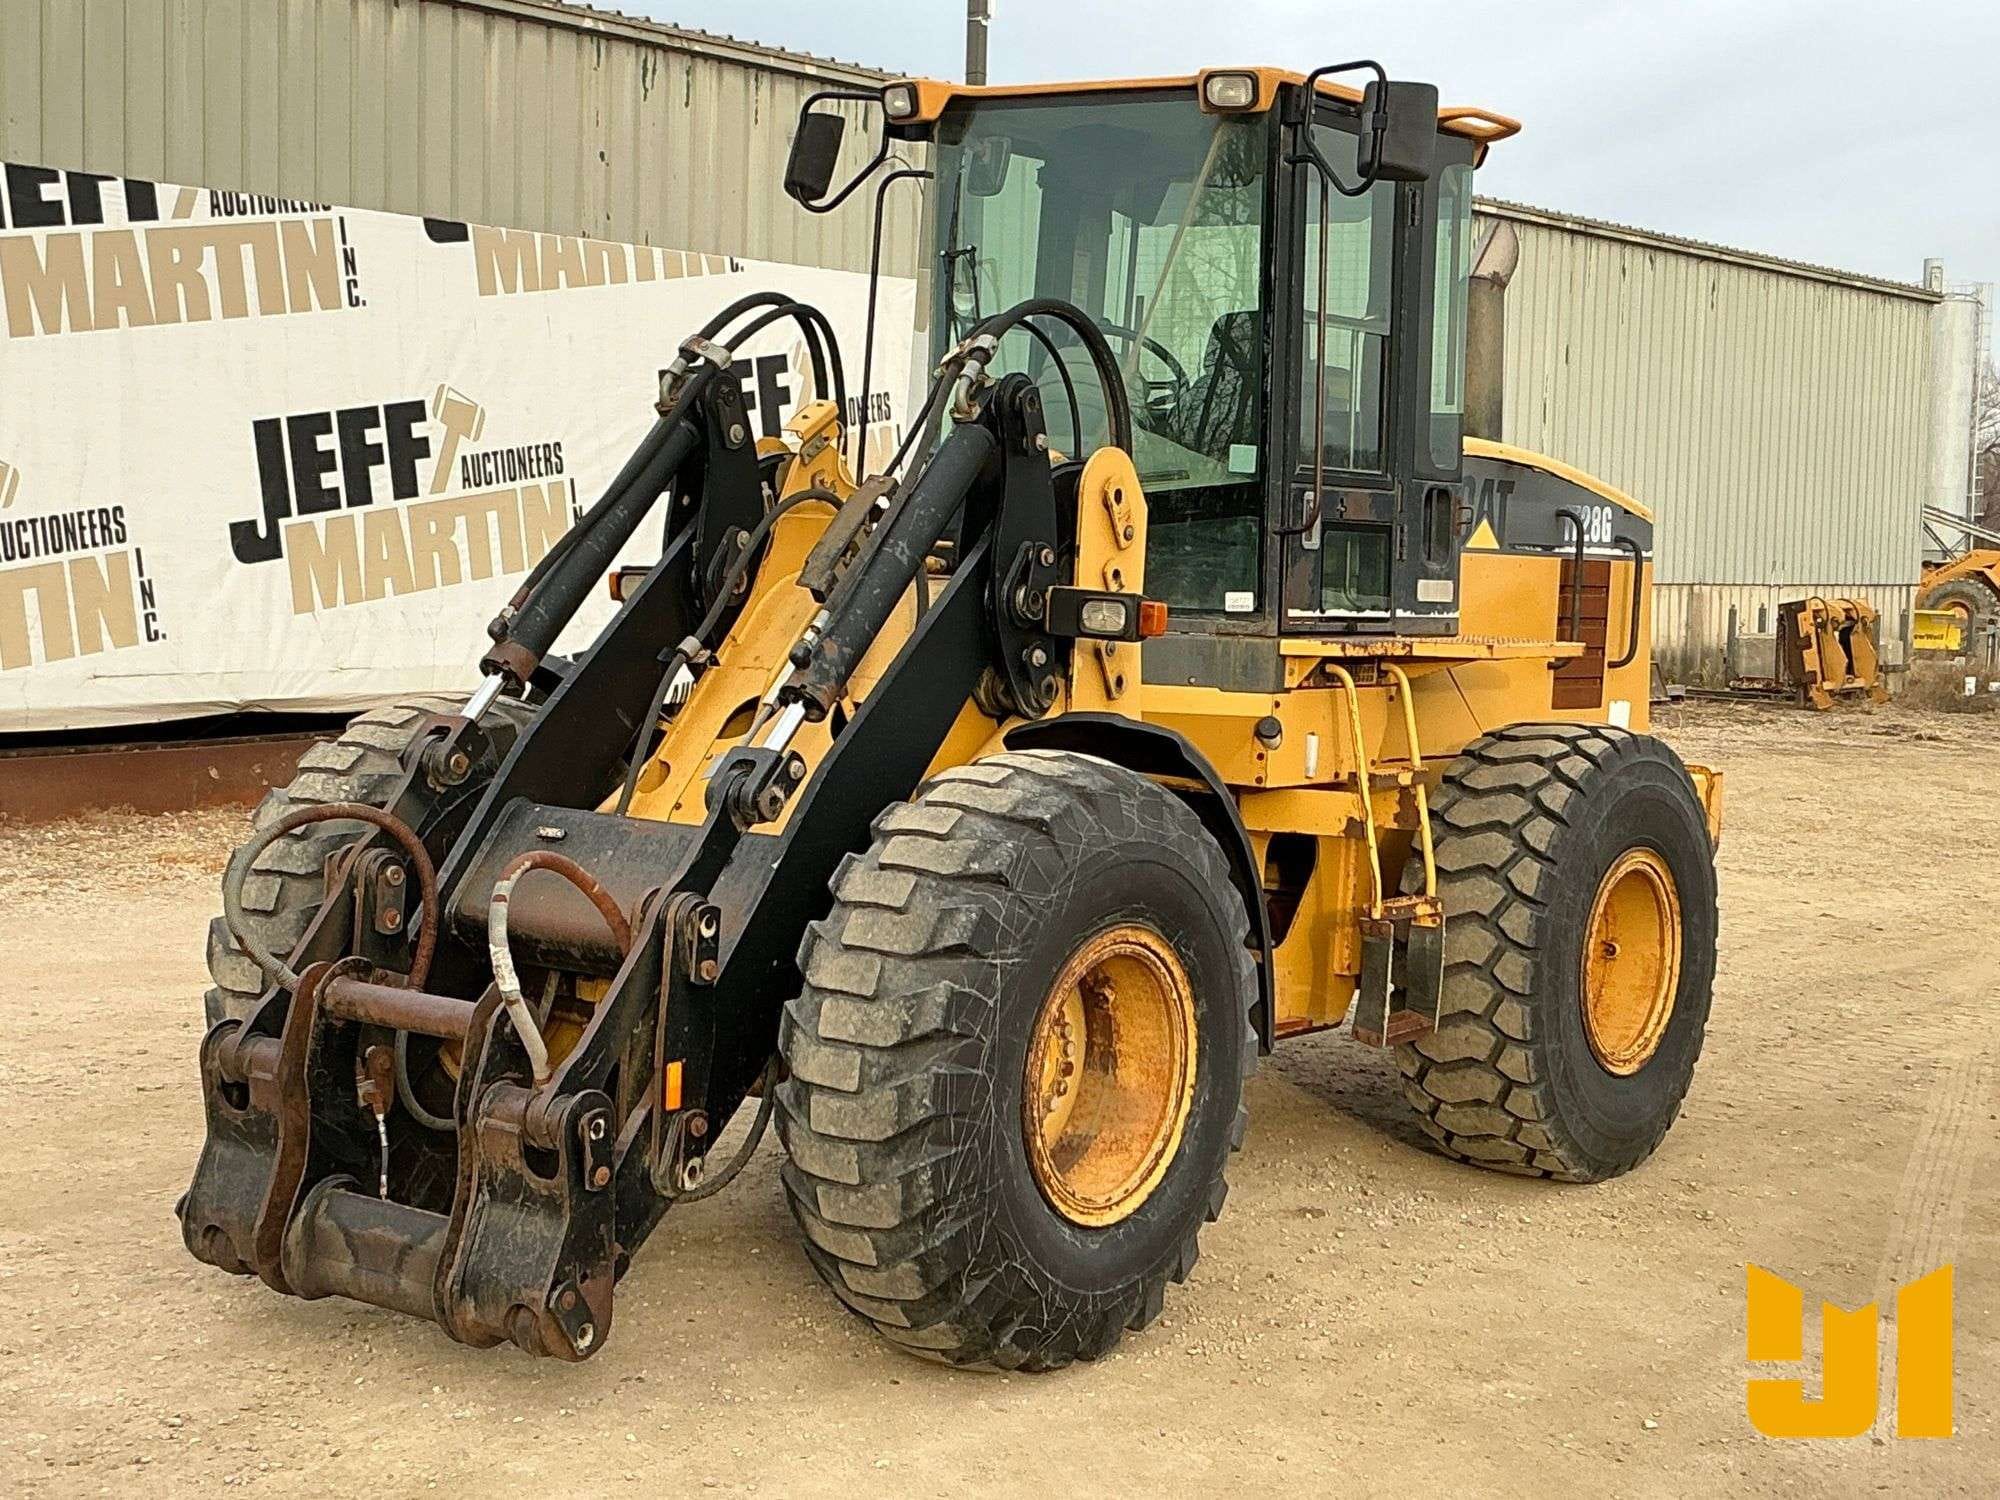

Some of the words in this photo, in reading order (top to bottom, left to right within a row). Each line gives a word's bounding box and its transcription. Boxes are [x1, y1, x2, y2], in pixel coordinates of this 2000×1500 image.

[0, 218, 343, 339] MARTIN
[339, 216, 367, 307] INC.
[229, 400, 431, 564] JEFF
[461, 441, 564, 490] AUCTIONEERS
[0, 505, 127, 563] UCTIONEERS
[284, 479, 569, 615] MARTIN
[0, 550, 140, 671] TIN
[135, 547, 167, 643] INC.
